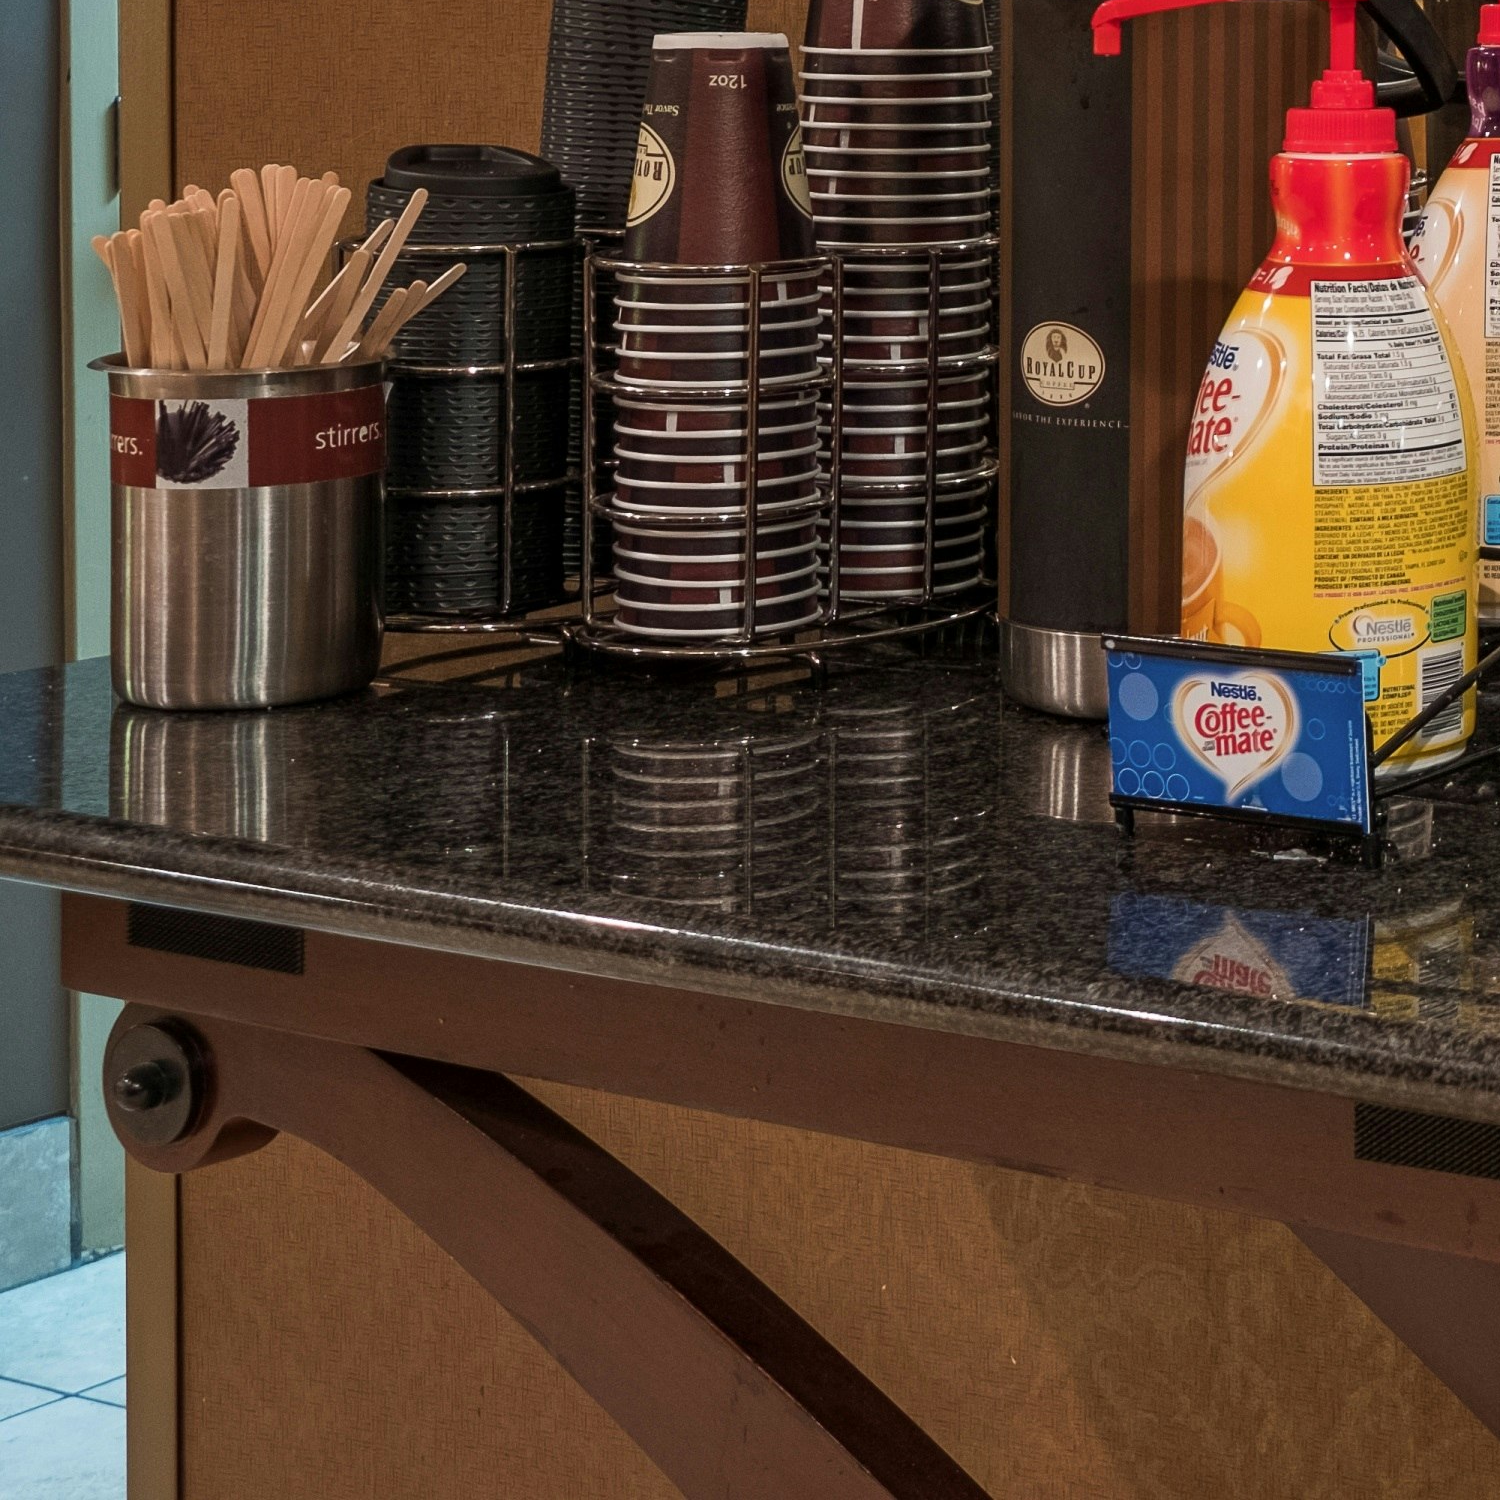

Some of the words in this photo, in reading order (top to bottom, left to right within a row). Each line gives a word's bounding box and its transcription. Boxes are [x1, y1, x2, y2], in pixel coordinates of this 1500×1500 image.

[709, 75, 747, 89] 12oz
[655, 104, 680, 116] Savor
[315, 421, 383, 449] stirrers.
[1187, 418, 1231, 456] ate
[1366, 618, 1411, 635] Nestlé
[1210, 681, 1258, 701] Nestlé
[1194, 702, 1273, 739] Coffee-
[1216, 729, 1274, 757] mate
